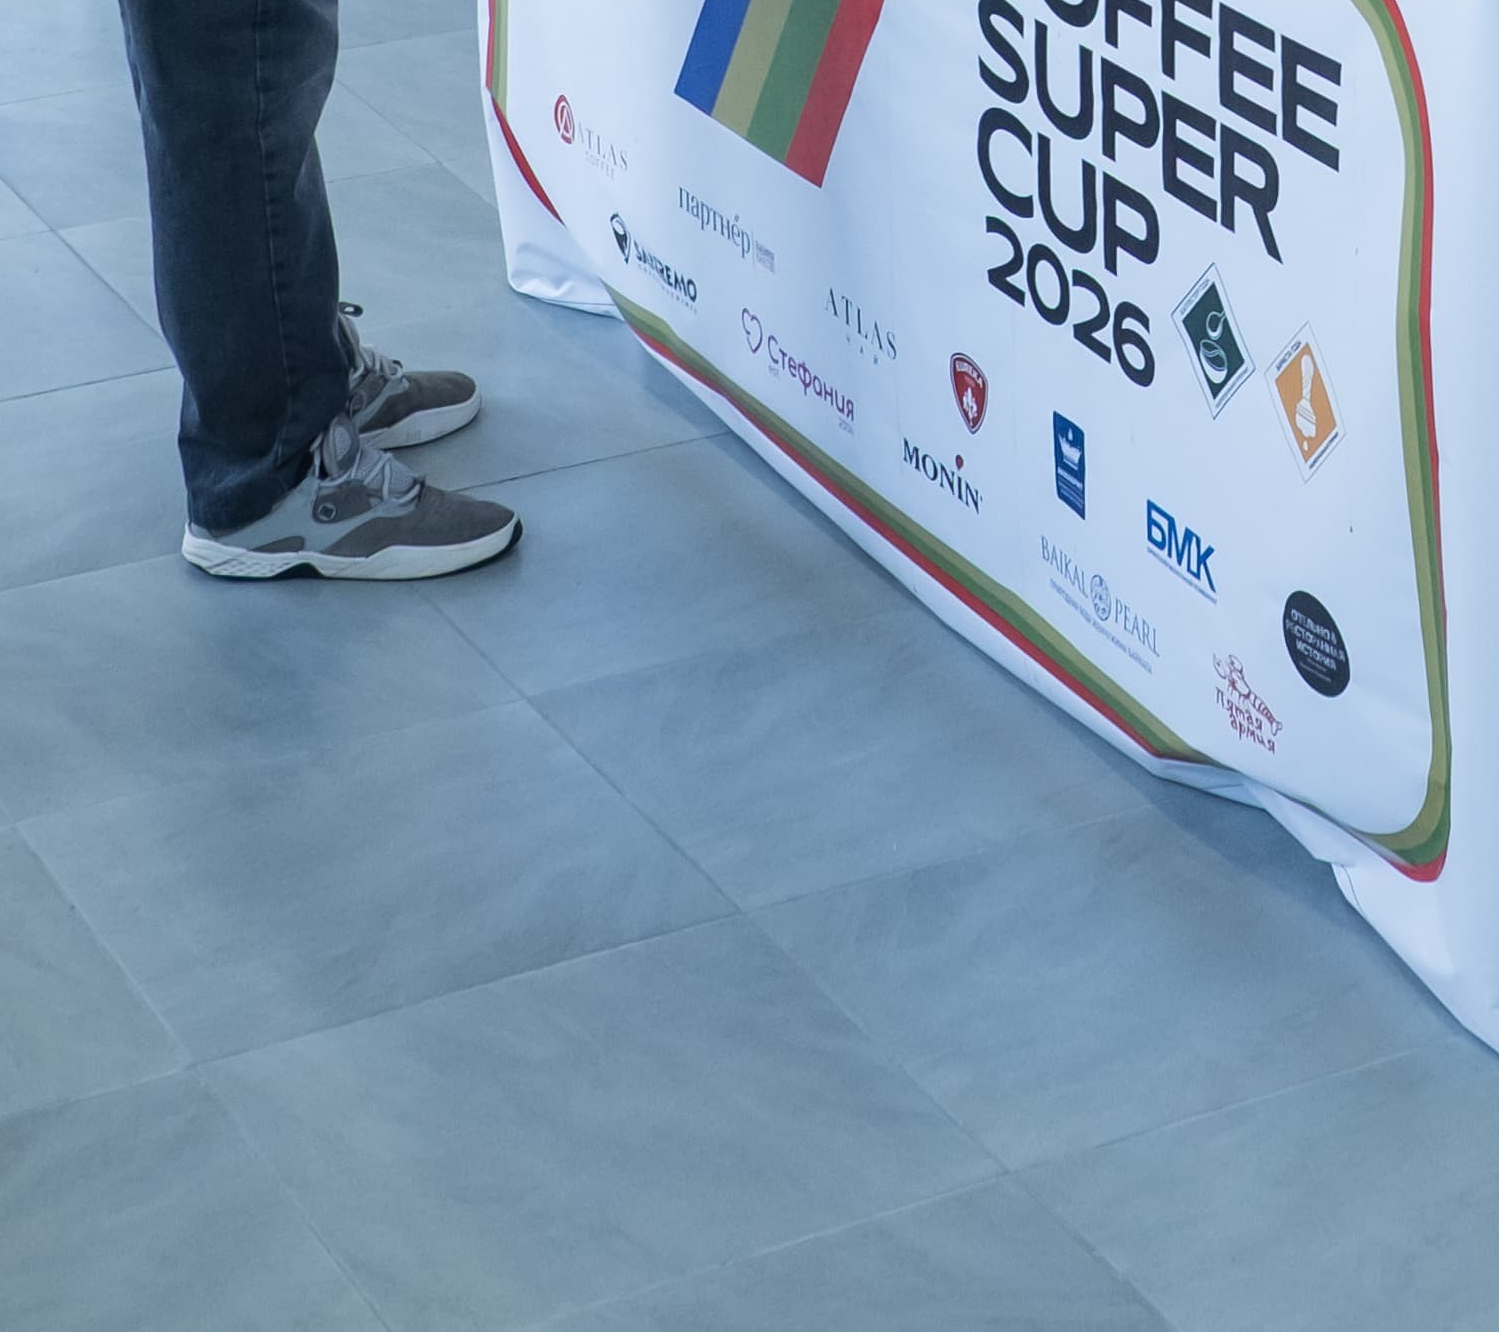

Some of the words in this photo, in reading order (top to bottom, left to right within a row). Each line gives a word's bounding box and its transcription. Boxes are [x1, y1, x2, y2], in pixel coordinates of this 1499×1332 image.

[578, 121, 628, 172] ATLAS
[977, 107, 1160, 276] CUP
[825, 288, 897, 360] ATLAS
[986, 216, 1155, 388] 2026
[768, 335, 854, 421] Стефания
[903, 438, 980, 515] MONIN
[1147, 499, 1216, 593] БМК
[1041, 535, 1088, 598] BAIKAL
[1115, 598, 1160, 657] PEARL
